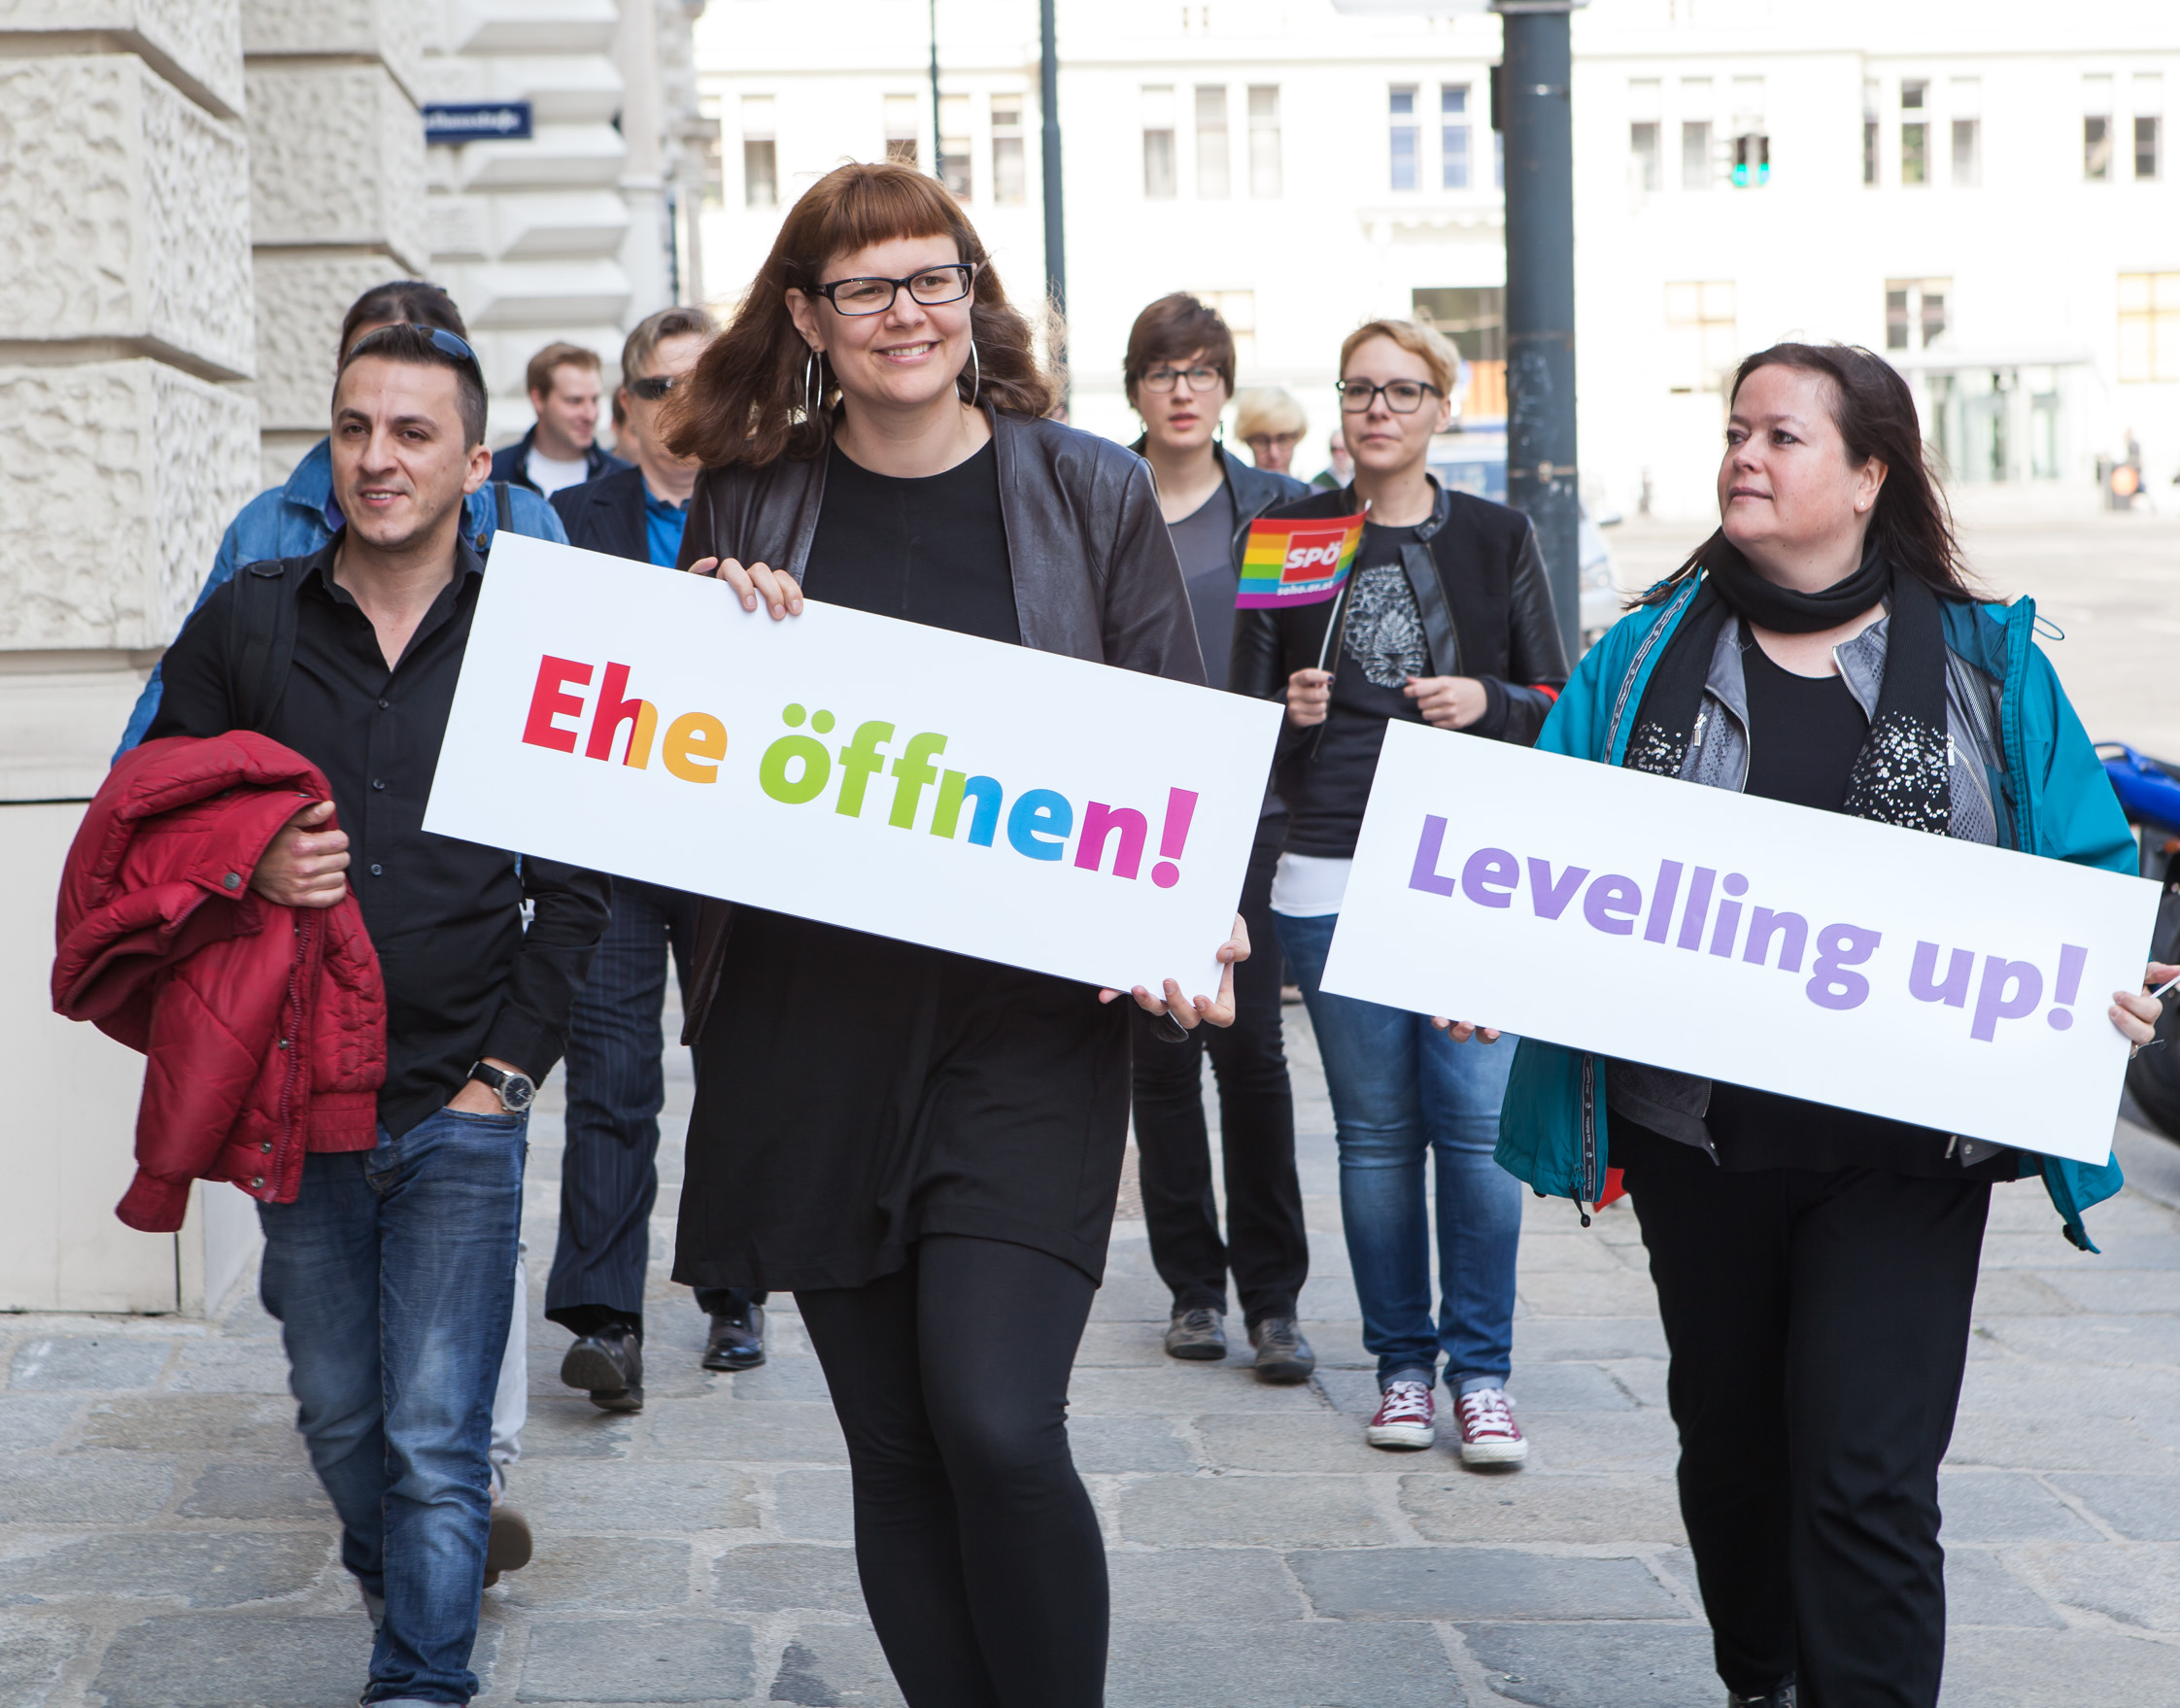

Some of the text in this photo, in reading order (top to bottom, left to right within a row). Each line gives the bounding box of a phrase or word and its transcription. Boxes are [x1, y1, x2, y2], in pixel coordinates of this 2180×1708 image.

[1285, 541, 1342, 569] SPÖ
[522, 655, 1199, 889] Ehe öffnen!
[1409, 814, 2087, 1042] Levelling up!
